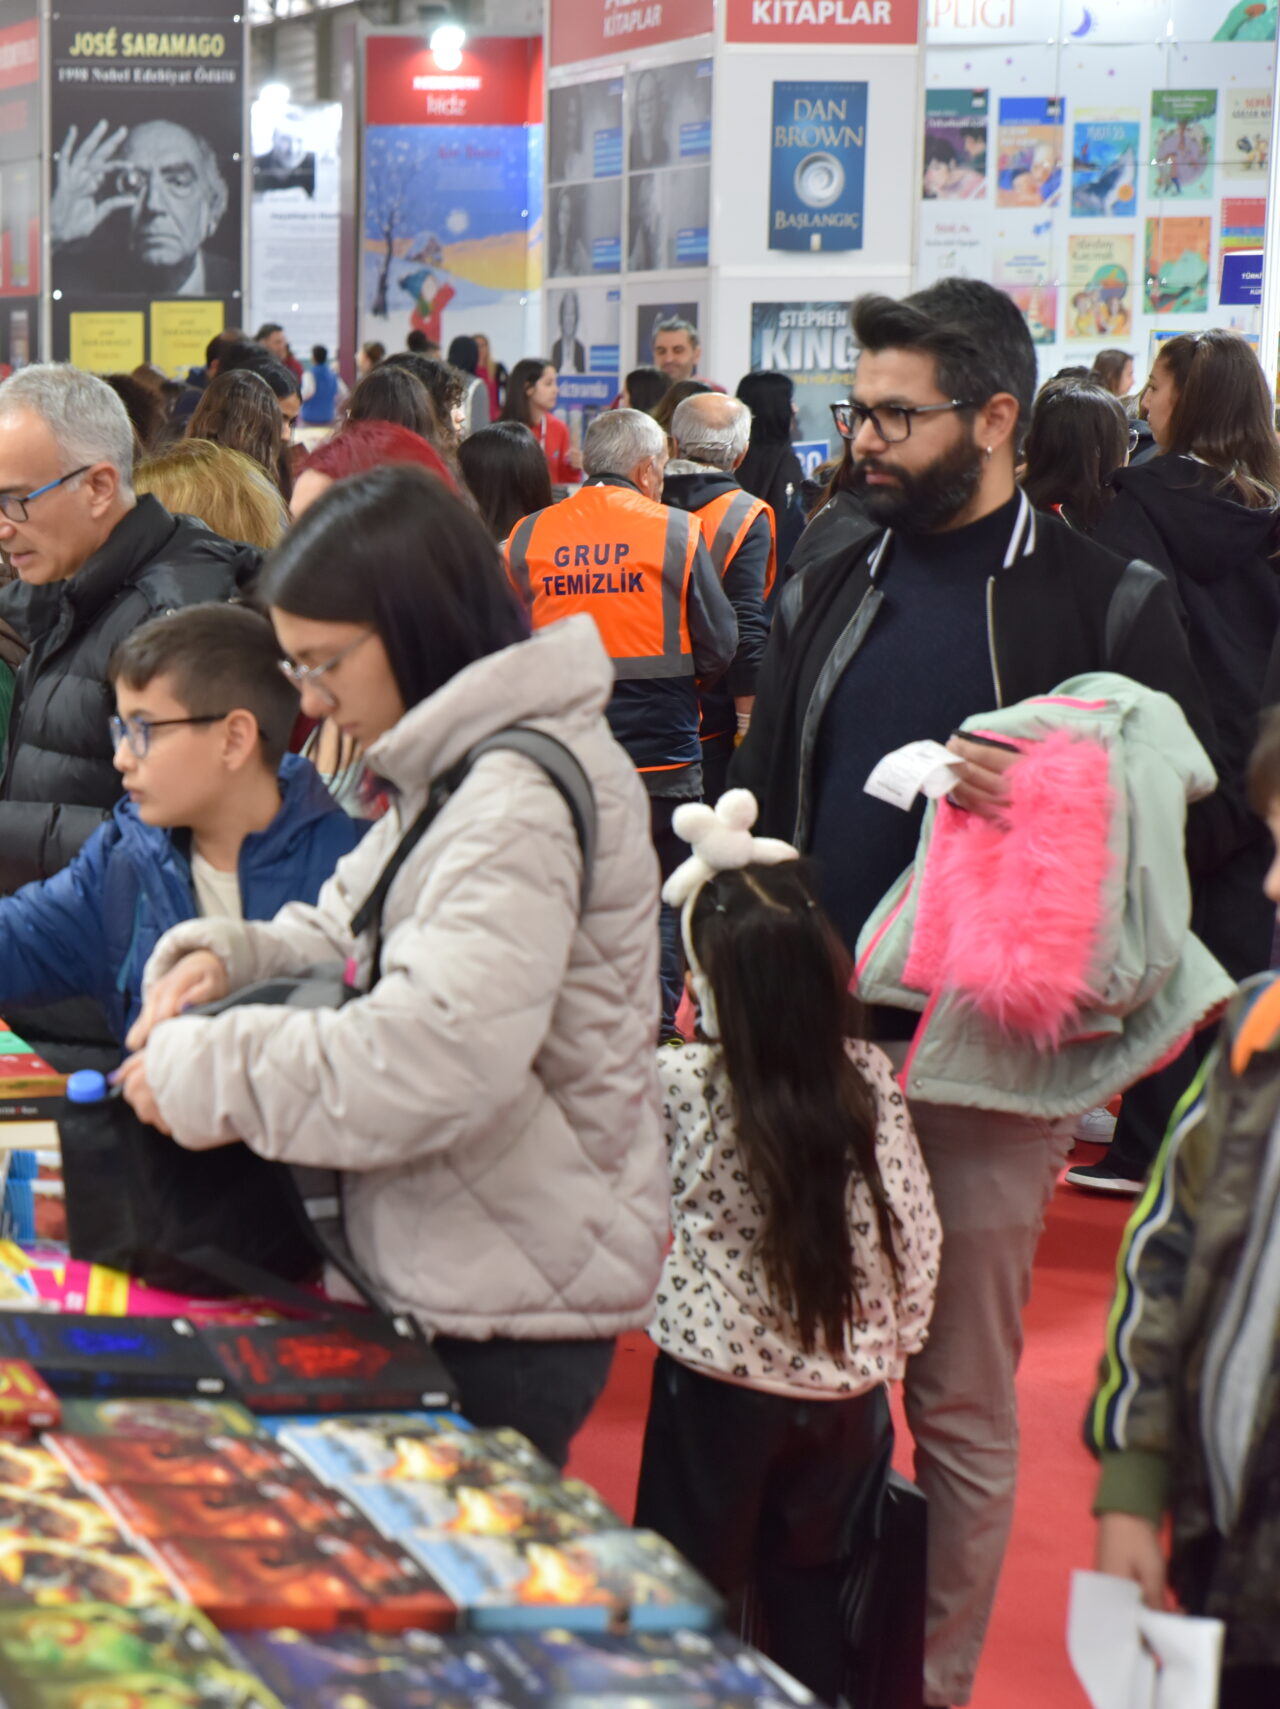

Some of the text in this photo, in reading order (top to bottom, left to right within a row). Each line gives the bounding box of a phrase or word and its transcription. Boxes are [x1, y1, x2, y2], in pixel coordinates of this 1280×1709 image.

[602, 4, 662, 38] KİTAPLAR
[69, 26, 118, 57] JOSÉ
[122, 33, 226, 57] SARAMAGO
[58, 65, 237, 85] 1998 Nobel Edebiyat Ödülü
[793, 98, 848, 122] DAN
[774, 125, 865, 149] BROWN
[775, 210, 861, 231] BAŞLANGIÇ
[779, 311, 848, 328] STEPHEN
[761, 328, 861, 371] KING
[554, 543, 630, 568] GRUP
[542, 567, 645, 596] TEMİZLİK
